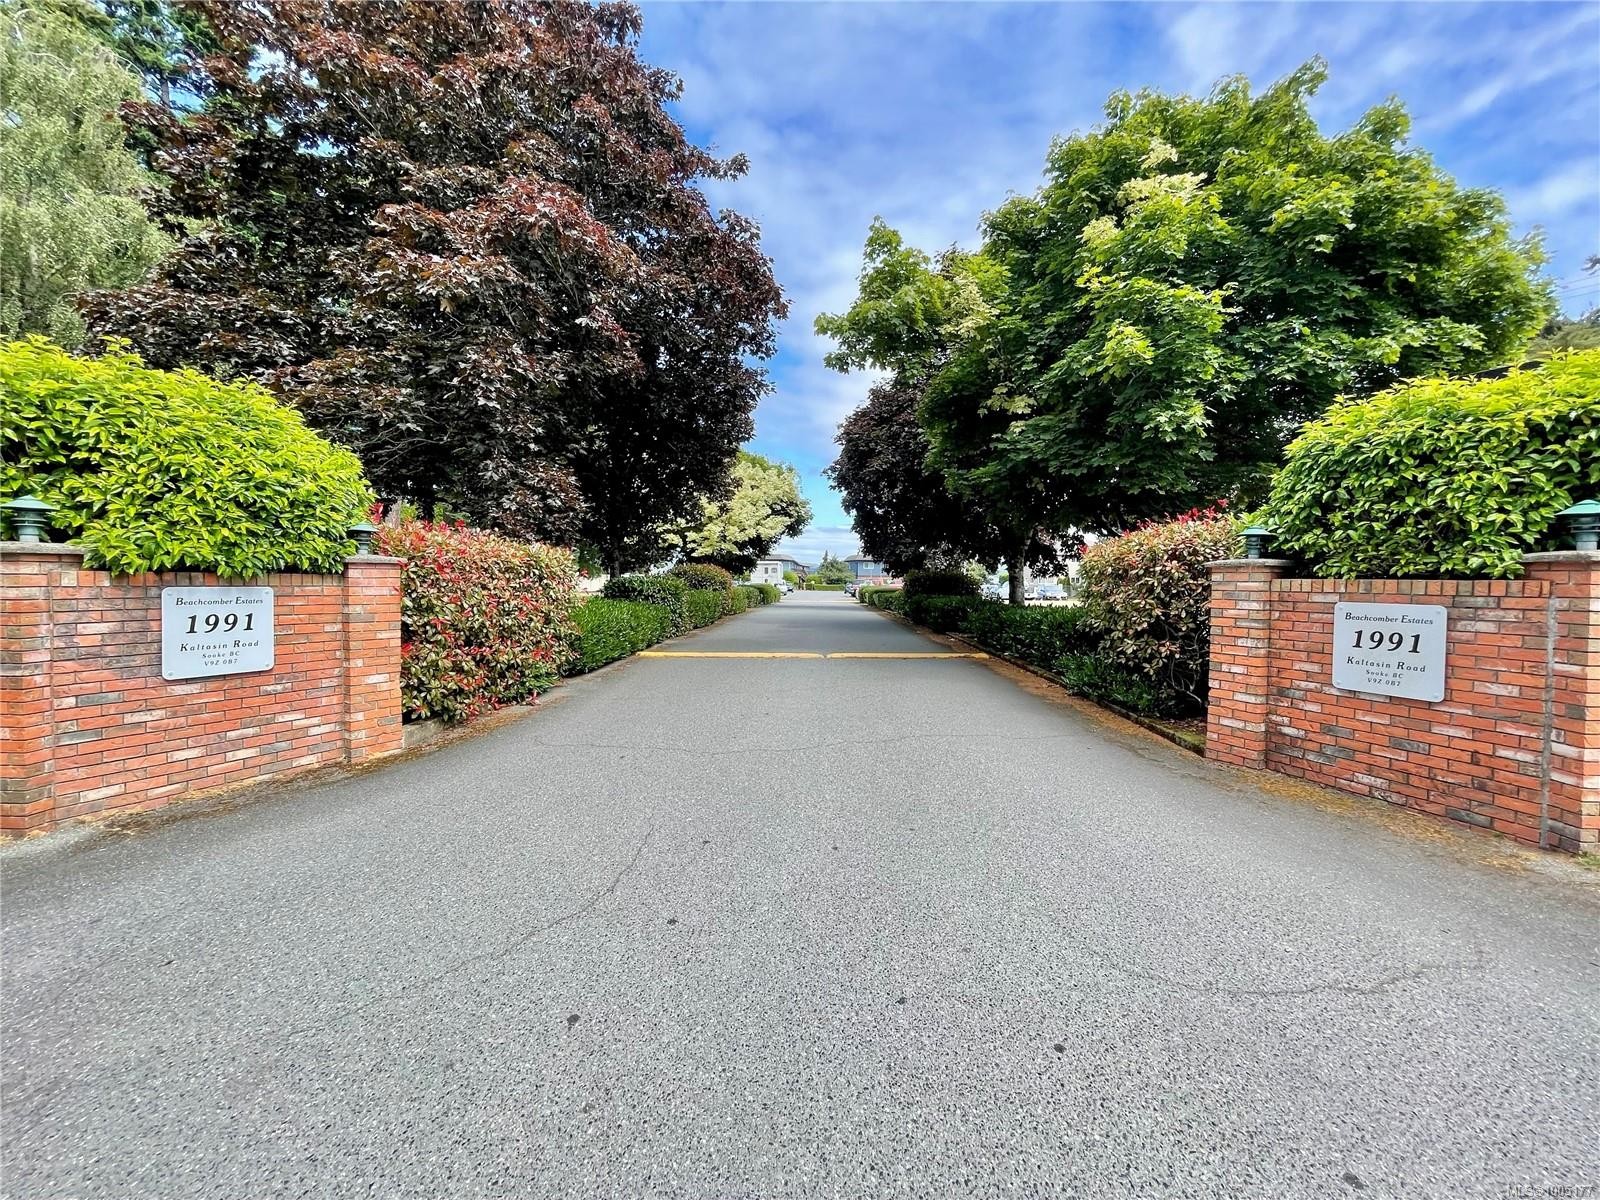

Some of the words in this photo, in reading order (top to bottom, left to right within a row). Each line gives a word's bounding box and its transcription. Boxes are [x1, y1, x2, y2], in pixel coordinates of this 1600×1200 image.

[175, 597, 233, 606] Beachcomber
[235, 596, 264, 605] Estates
[185, 612, 254, 634] 1991
[1344, 612, 1399, 623] Beachcomber
[1400, 614, 1434, 625] Estates
[180, 643, 228, 652] Kaltasin
[233, 639, 259, 648] Road
[1352, 629, 1421, 654] 1991
[1346, 656, 1391, 669] Kaltasin
[1396, 661, 1426, 673] Road
[1365, 669, 1389, 678] Sooke
[1367, 677, 1382, 685] V9Z
